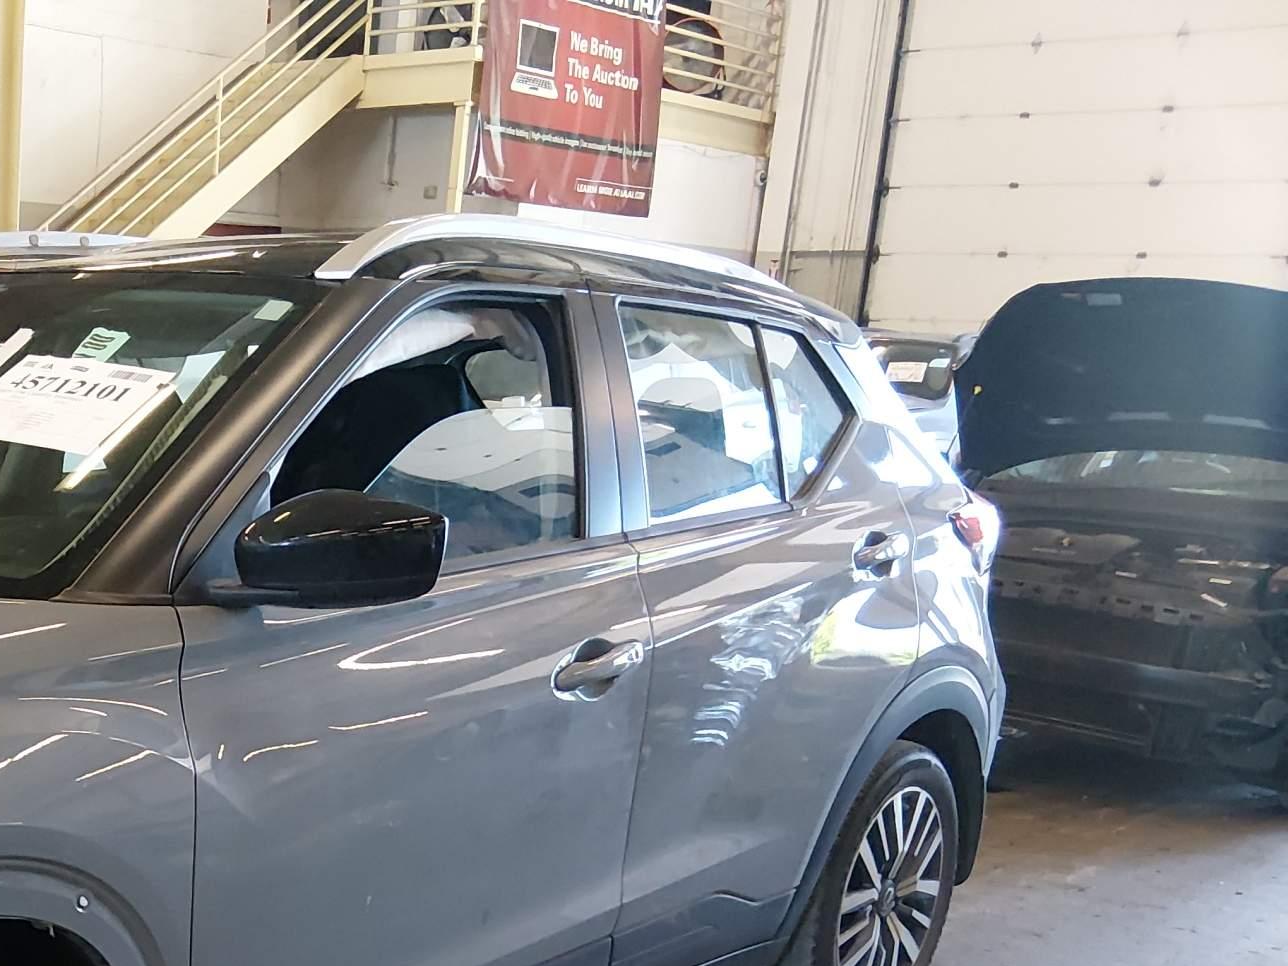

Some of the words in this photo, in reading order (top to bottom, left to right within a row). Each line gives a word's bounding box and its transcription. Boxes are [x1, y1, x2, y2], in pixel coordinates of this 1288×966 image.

[590, 36, 623, 66] Bring
[567, 57, 590, 80] The
[592, 63, 639, 91] Auction
[564, 82, 579, 104] To
[583, 86, 603, 109] You
[10, 372, 132, 402] 45712101
